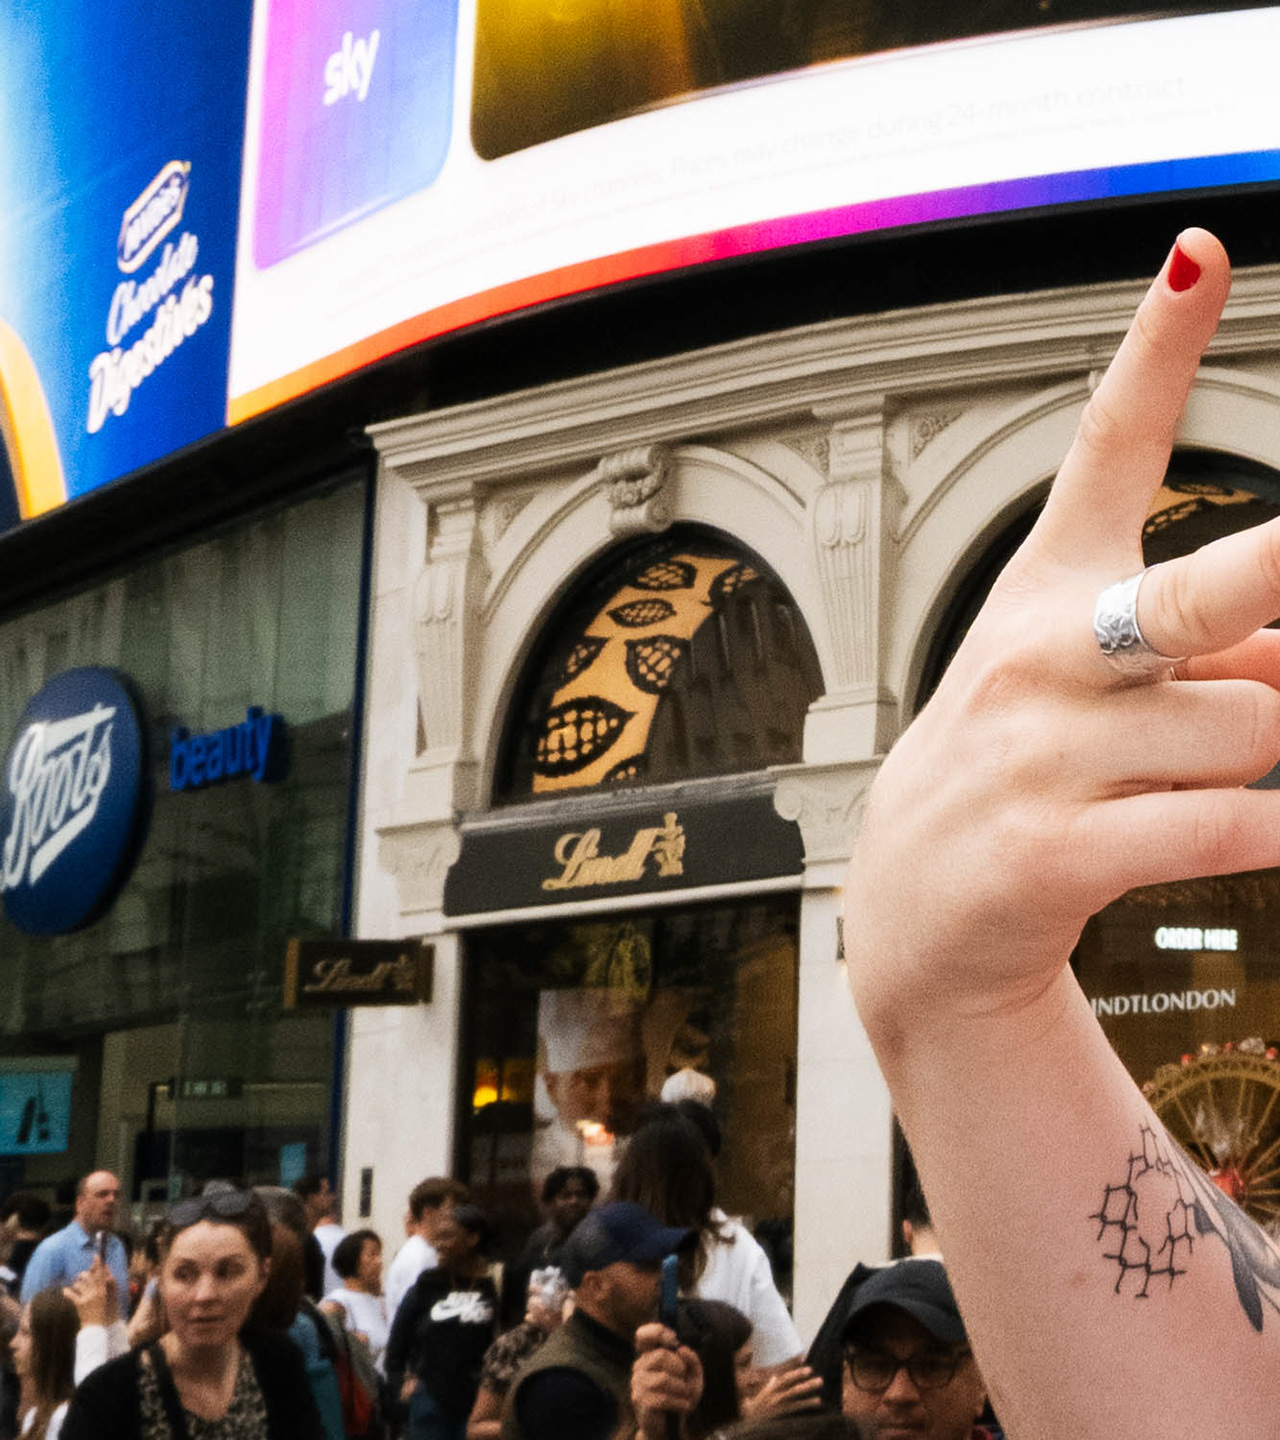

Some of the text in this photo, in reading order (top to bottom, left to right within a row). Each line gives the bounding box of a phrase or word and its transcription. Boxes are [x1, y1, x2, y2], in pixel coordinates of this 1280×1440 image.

[323, 29, 380, 106] sky
[170, 706, 277, 791] beauty
[0, 702, 116, 892] Boots
[541, 819, 668, 891] Lindt
[1090, 988, 1237, 1018] INDTLONDON
